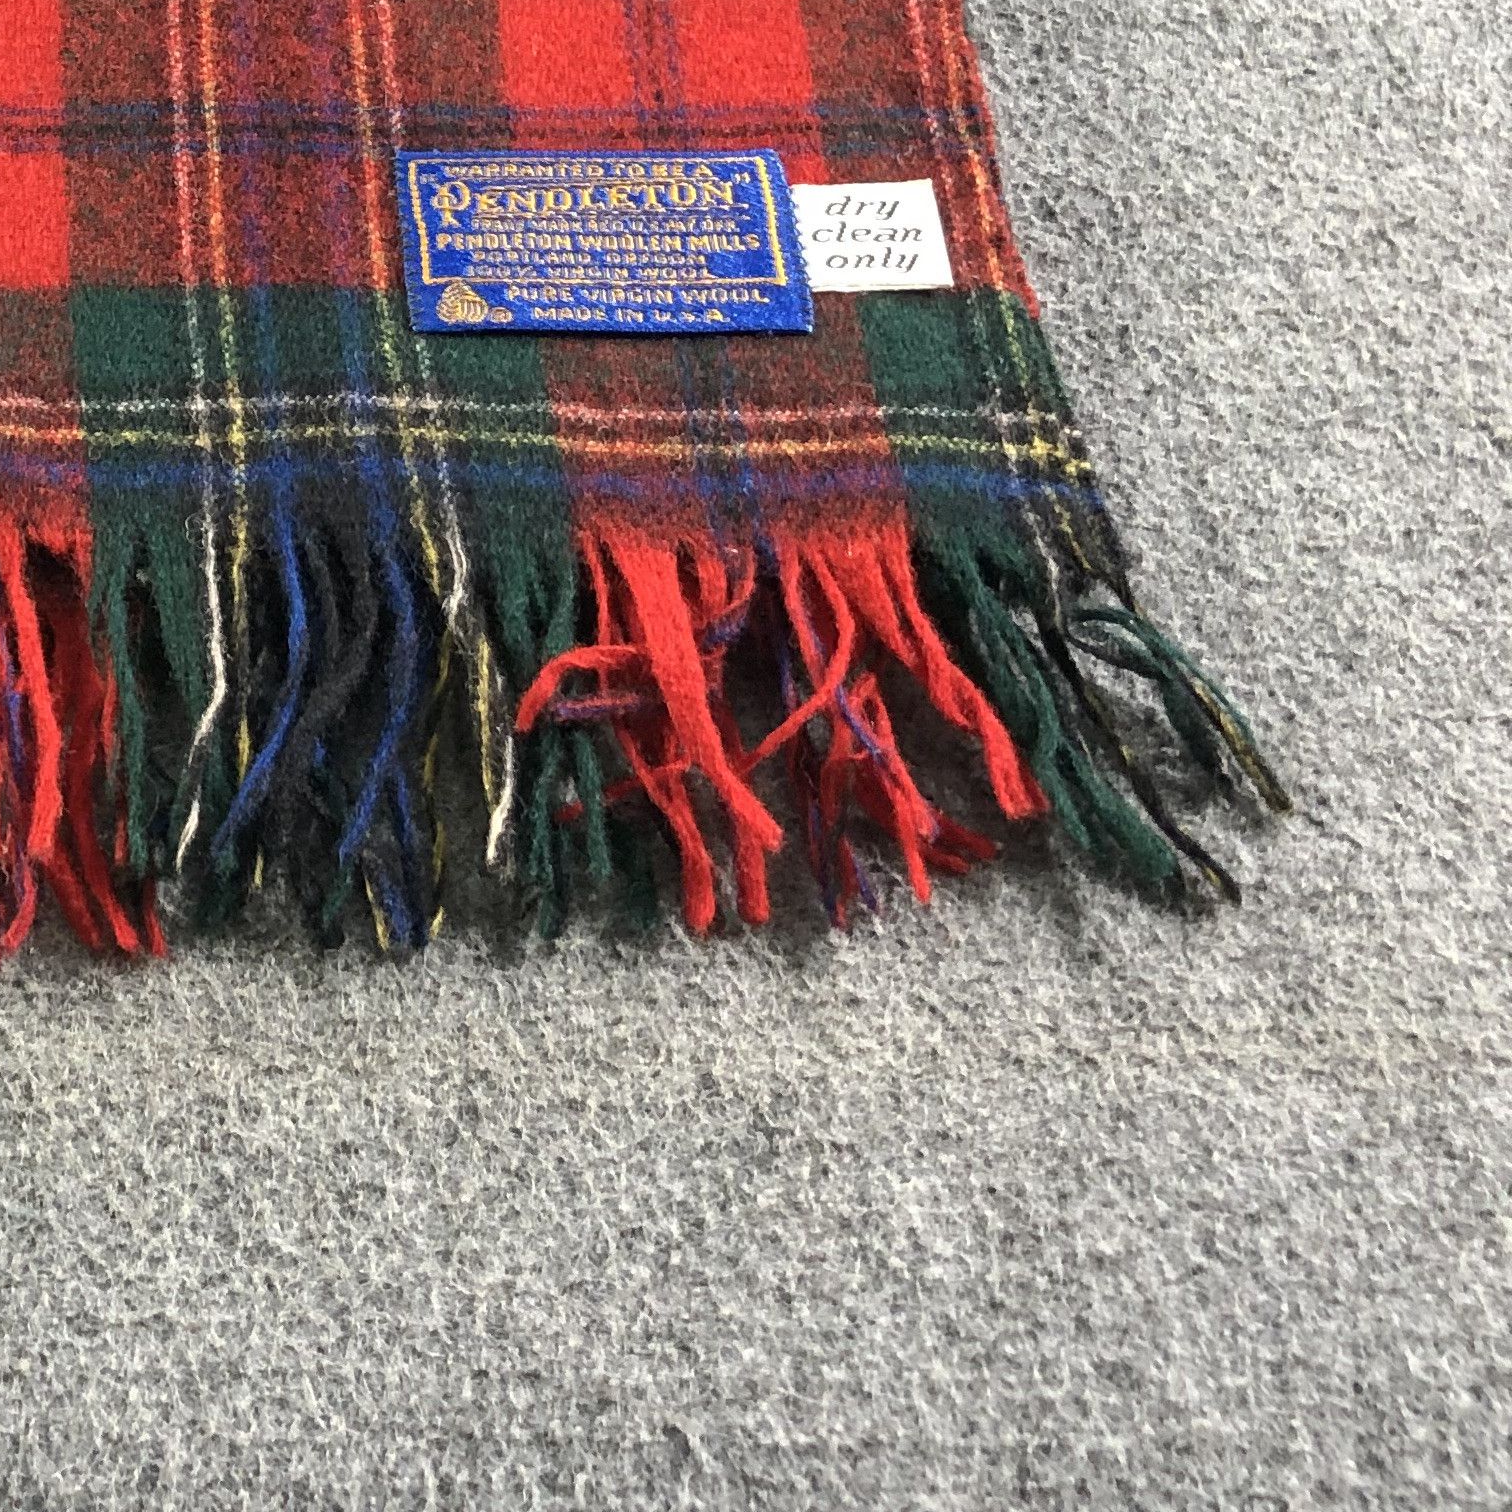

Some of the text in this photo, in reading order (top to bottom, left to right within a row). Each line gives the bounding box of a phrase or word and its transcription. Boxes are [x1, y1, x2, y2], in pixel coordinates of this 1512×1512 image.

[442, 162, 714, 178] WARRANTED TO BE A
[824, 195, 900, 221] dry
[811, 220, 923, 243] clean
[436, 232, 761, 252] PENDLETON WOOLEN MILLS
[825, 246, 919, 273] only
[546, 265, 629, 280] VIRGIN
[637, 265, 718, 280] WOOL
[505, 285, 771, 305] PURE VIRGIN WOOL
[531, 306, 607, 321] MADE
[614, 307, 644, 323] IN
